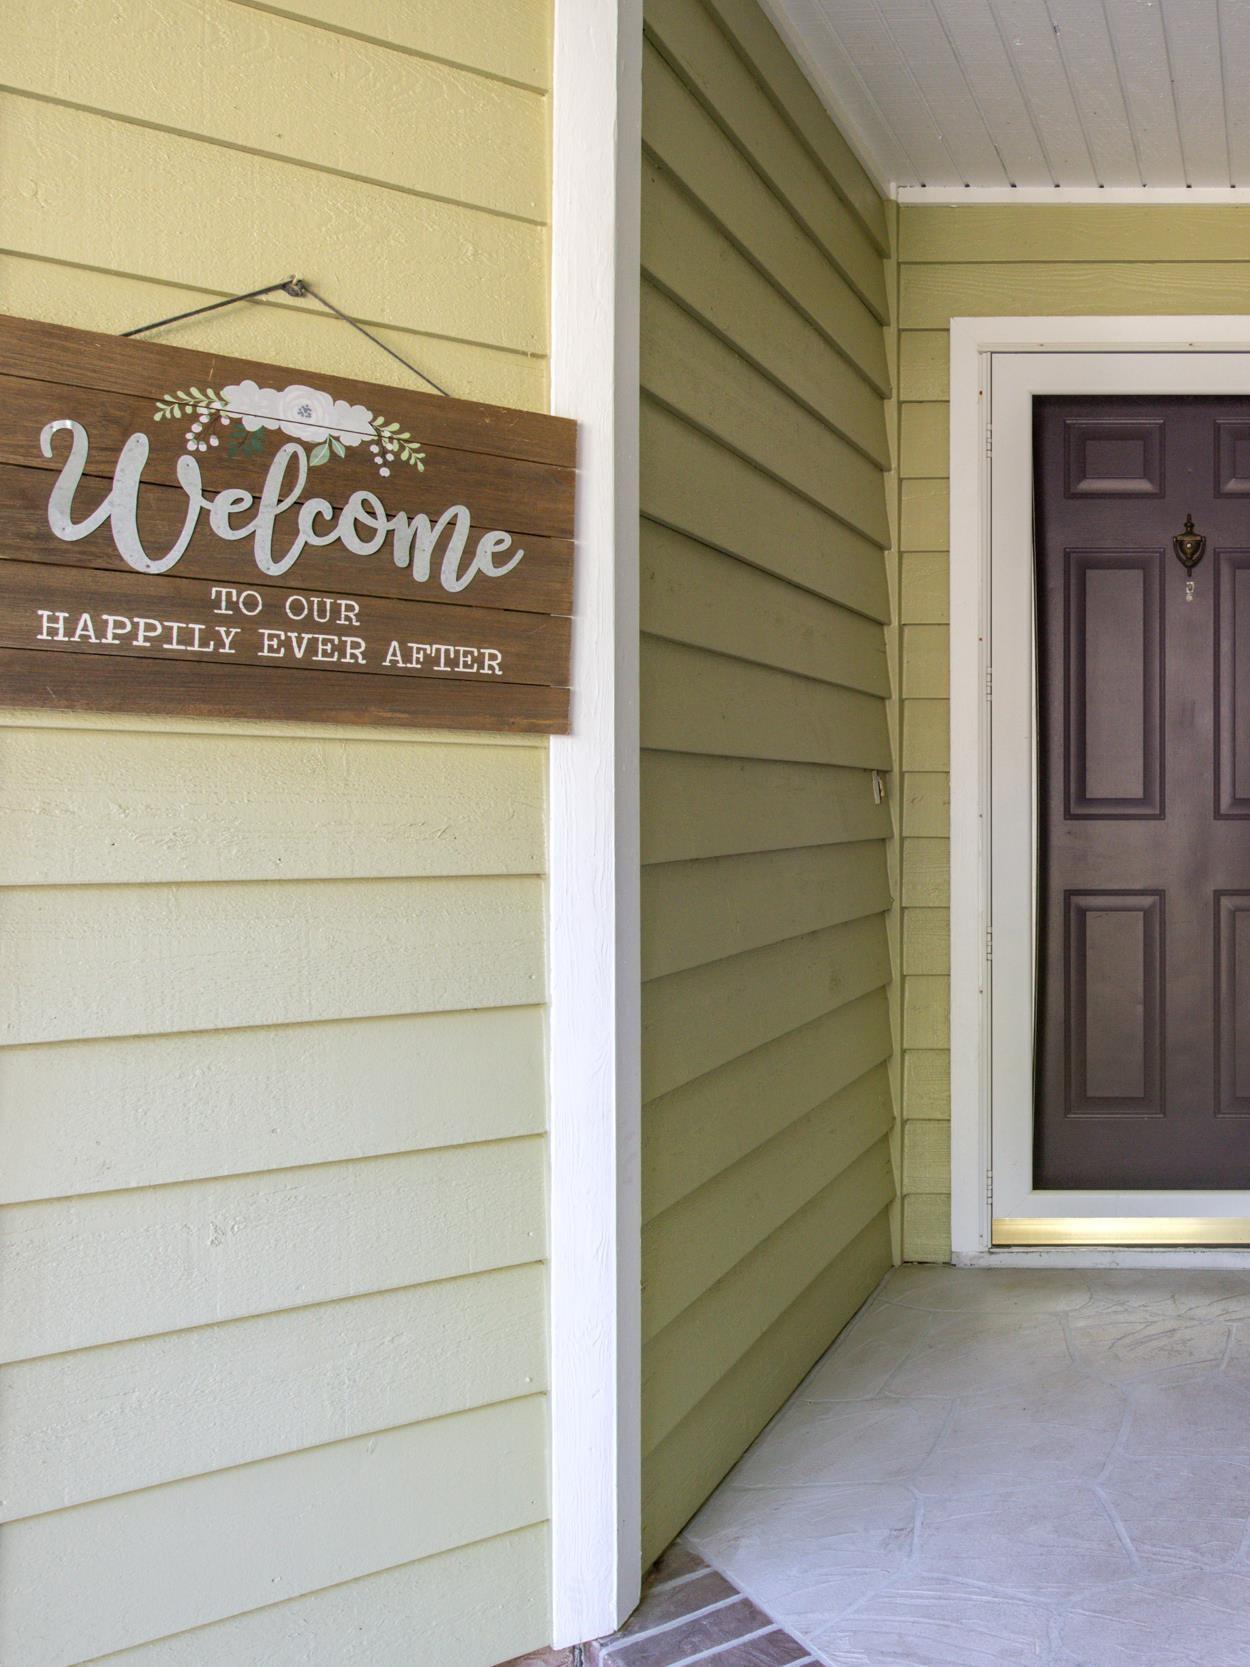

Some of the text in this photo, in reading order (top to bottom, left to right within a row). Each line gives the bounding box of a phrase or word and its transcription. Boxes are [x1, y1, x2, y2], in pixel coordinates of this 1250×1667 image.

[39, 418, 525, 593] Welcome
[211, 586, 361, 627] TO OUR
[36, 609, 504, 676] HAPPILY EVER AFTER
